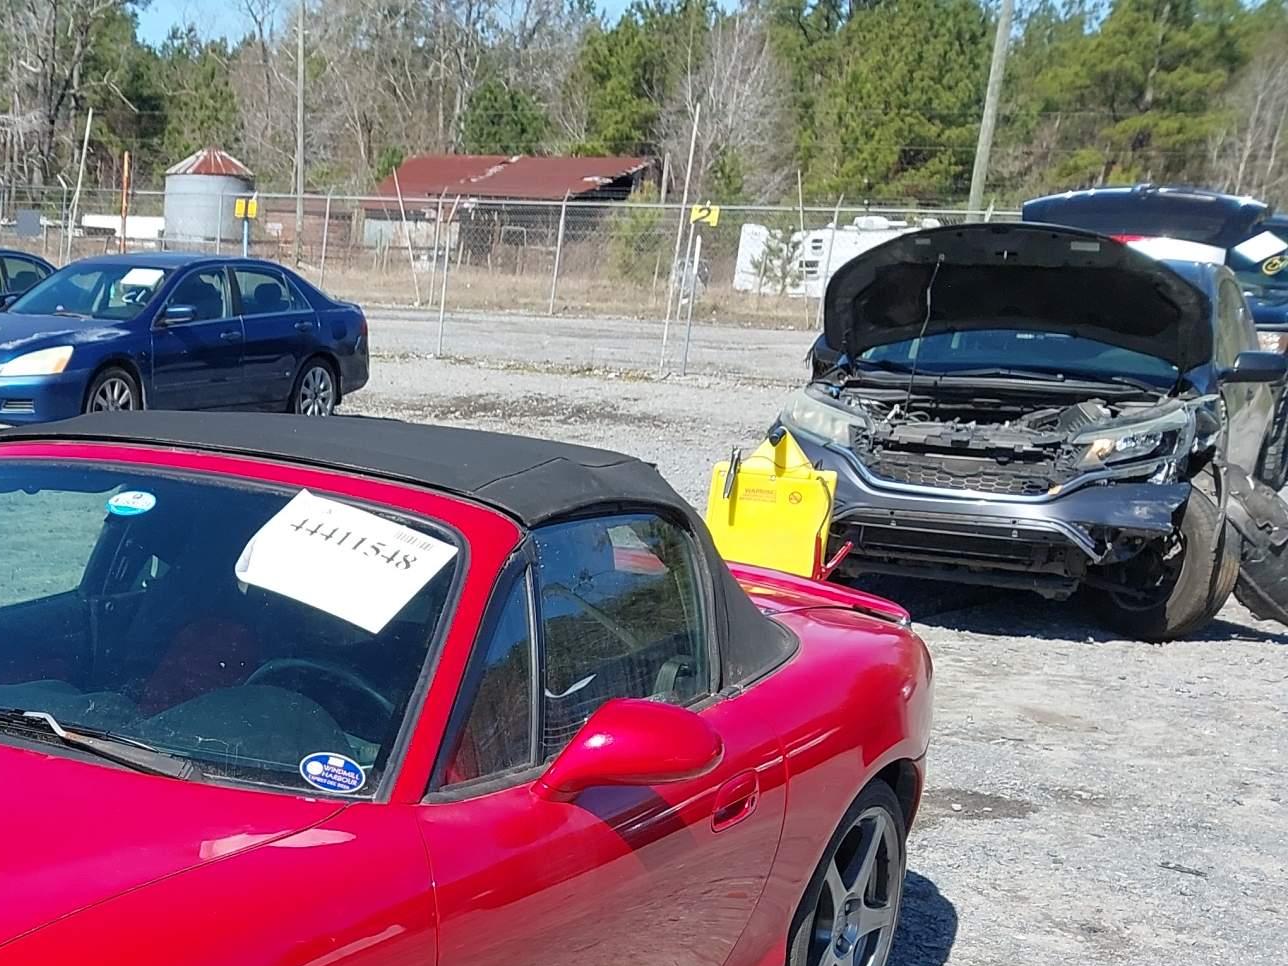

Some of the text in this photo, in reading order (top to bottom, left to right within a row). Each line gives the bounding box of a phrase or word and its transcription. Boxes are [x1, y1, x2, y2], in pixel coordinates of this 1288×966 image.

[692, 207, 712, 224] 2
[290, 518, 418, 570] 44411548
[321, 771, 358, 787] HARBOUR
[323, 764, 361, 780] WINDMILL
